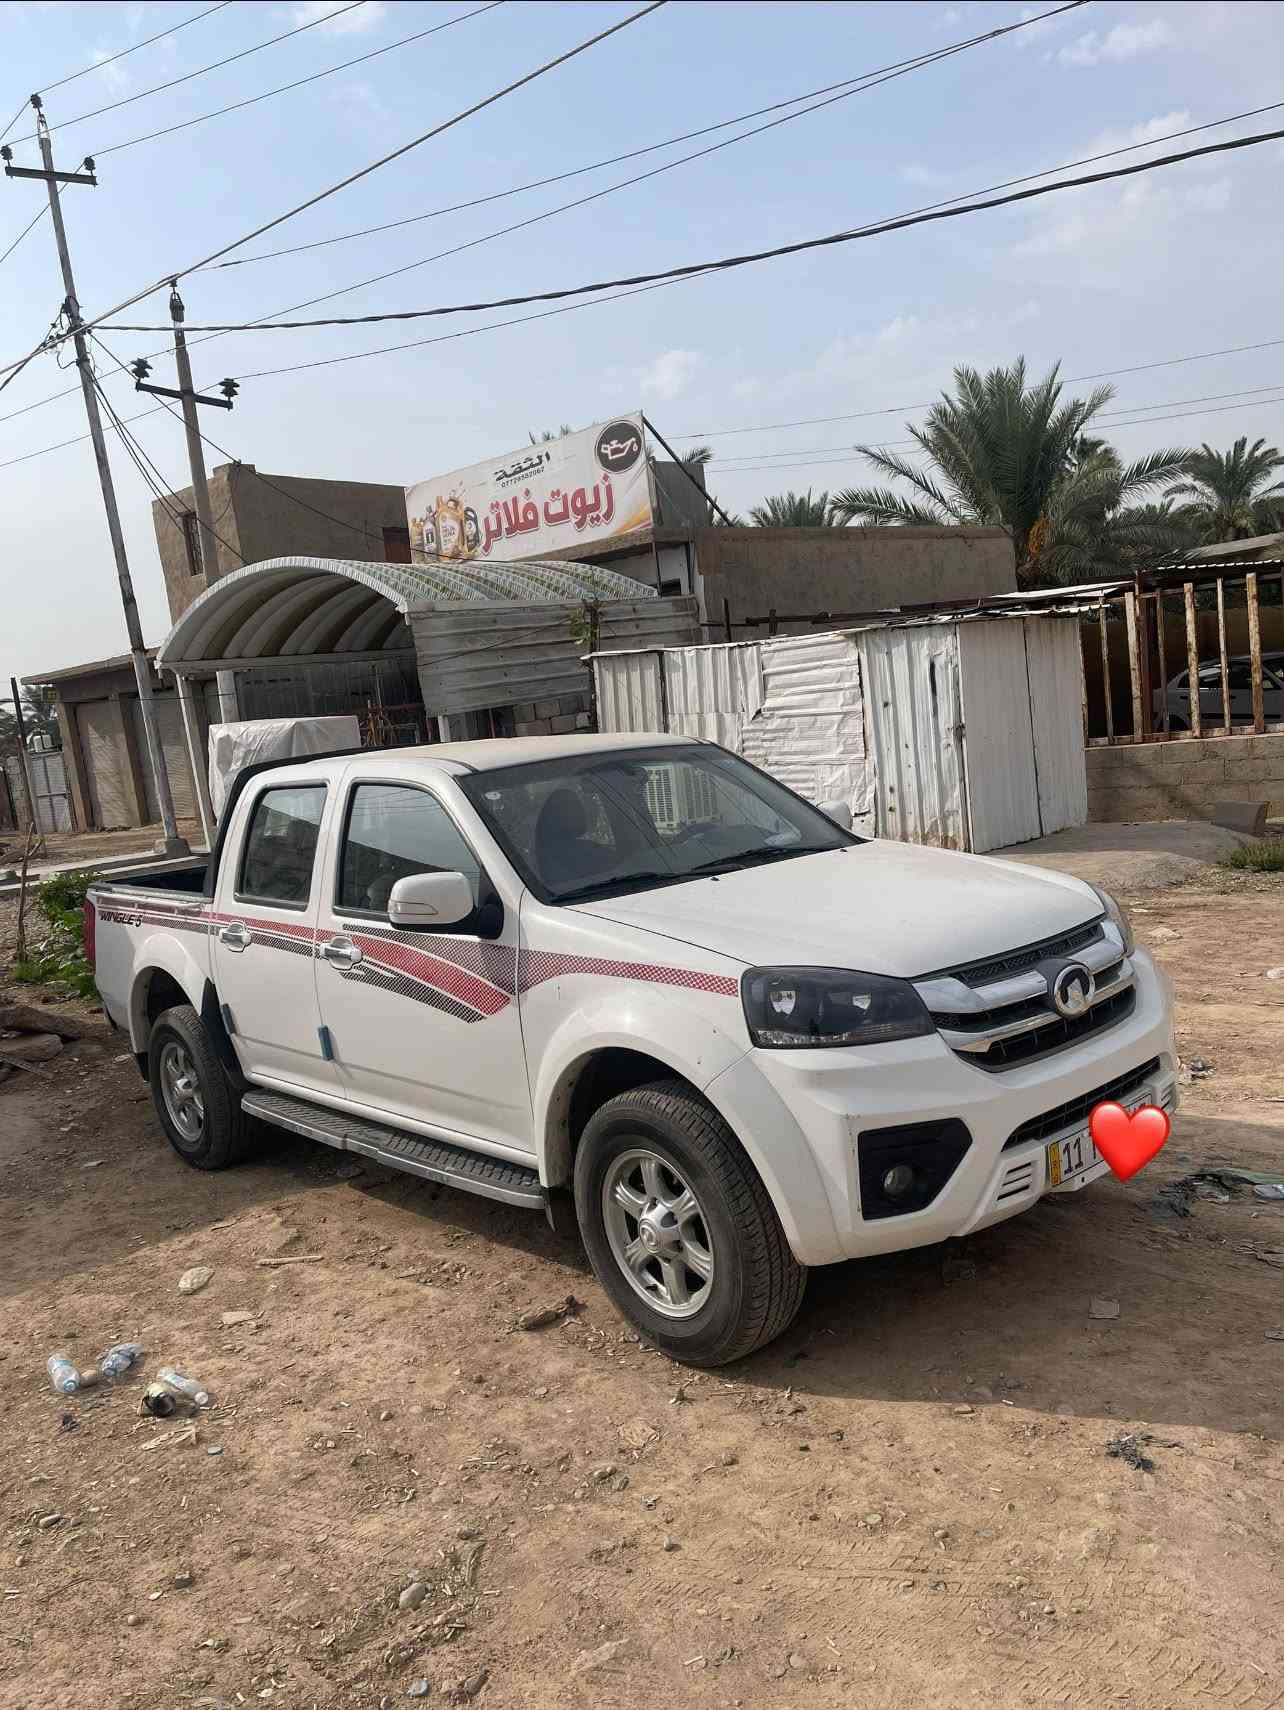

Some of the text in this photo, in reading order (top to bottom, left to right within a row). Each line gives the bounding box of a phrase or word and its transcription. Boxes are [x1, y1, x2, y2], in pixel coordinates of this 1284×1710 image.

[494, 451, 551, 481] الثقة
[481, 473, 615, 554] زيوت فلاتر
[98, 910, 135, 925] WINGLE
